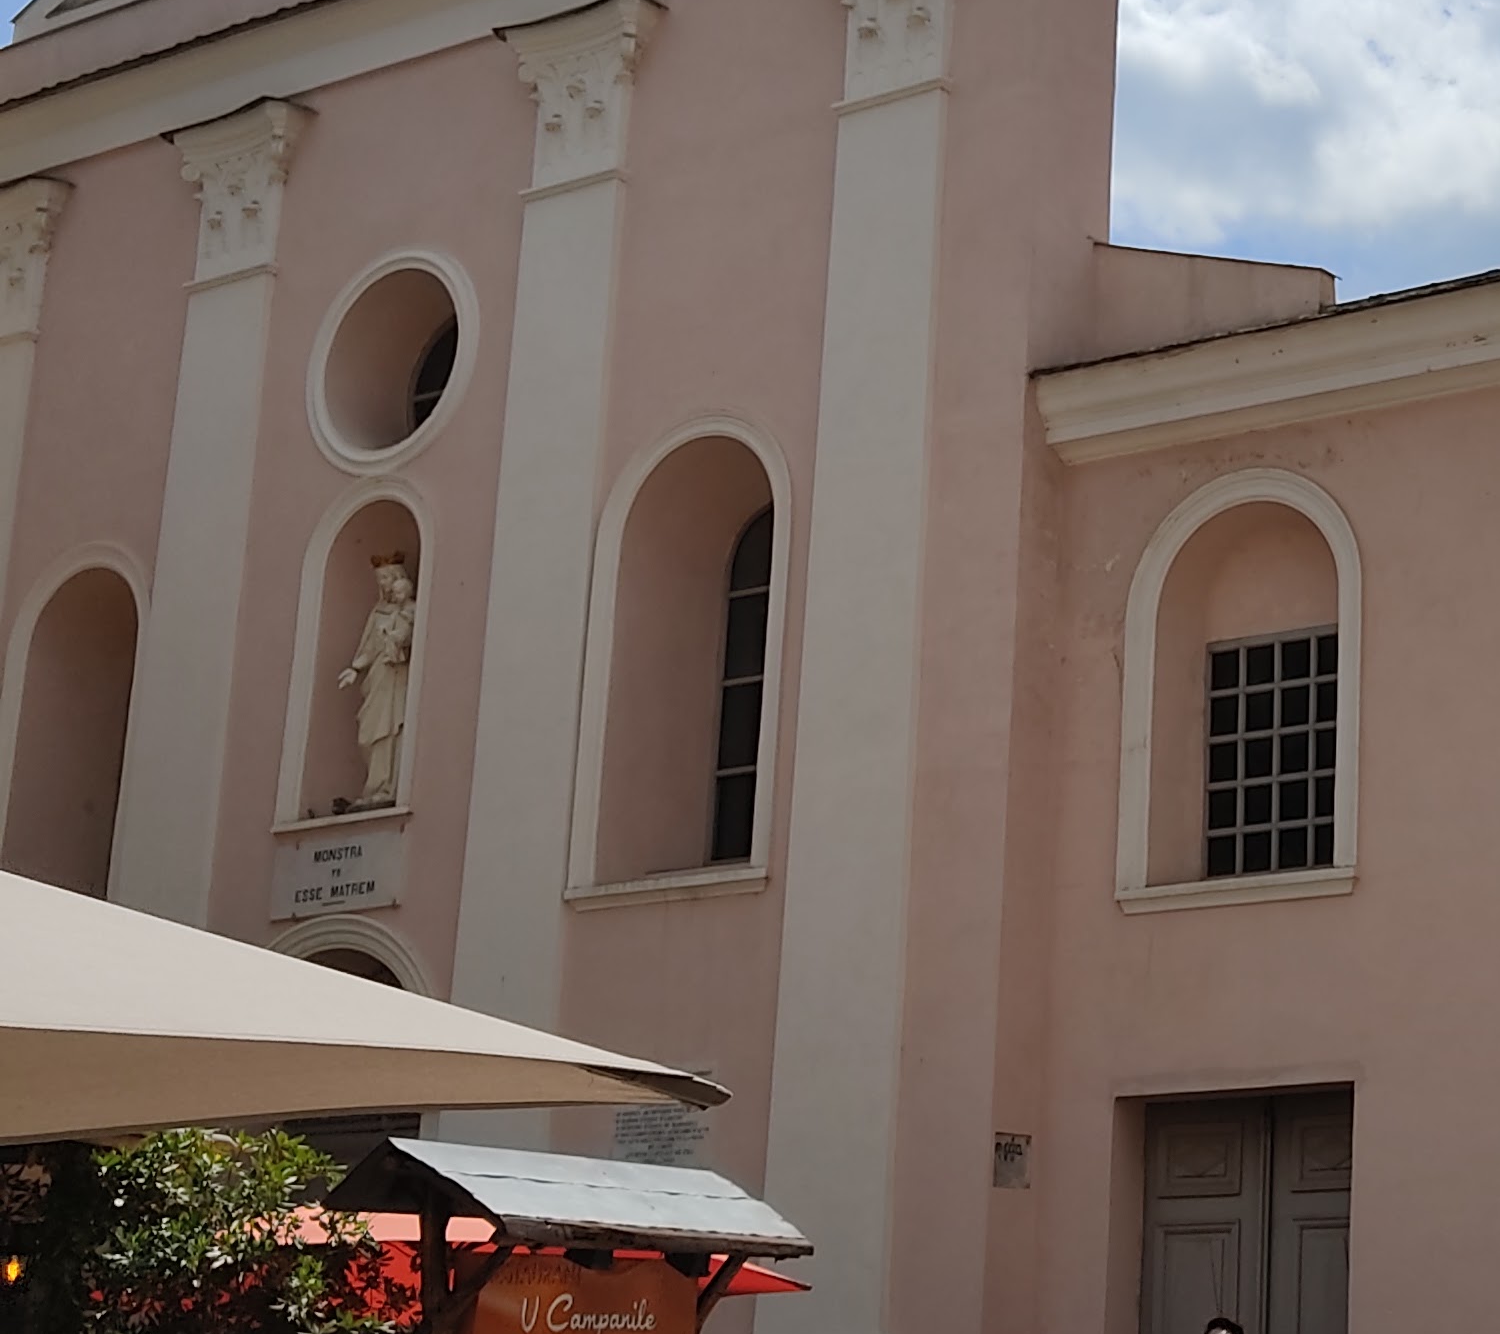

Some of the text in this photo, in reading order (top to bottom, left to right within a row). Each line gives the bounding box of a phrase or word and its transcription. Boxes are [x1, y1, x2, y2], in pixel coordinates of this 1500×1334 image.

[313, 845, 363, 863] MONSTRA
[294, 880, 375, 904] ESSE MATREM
